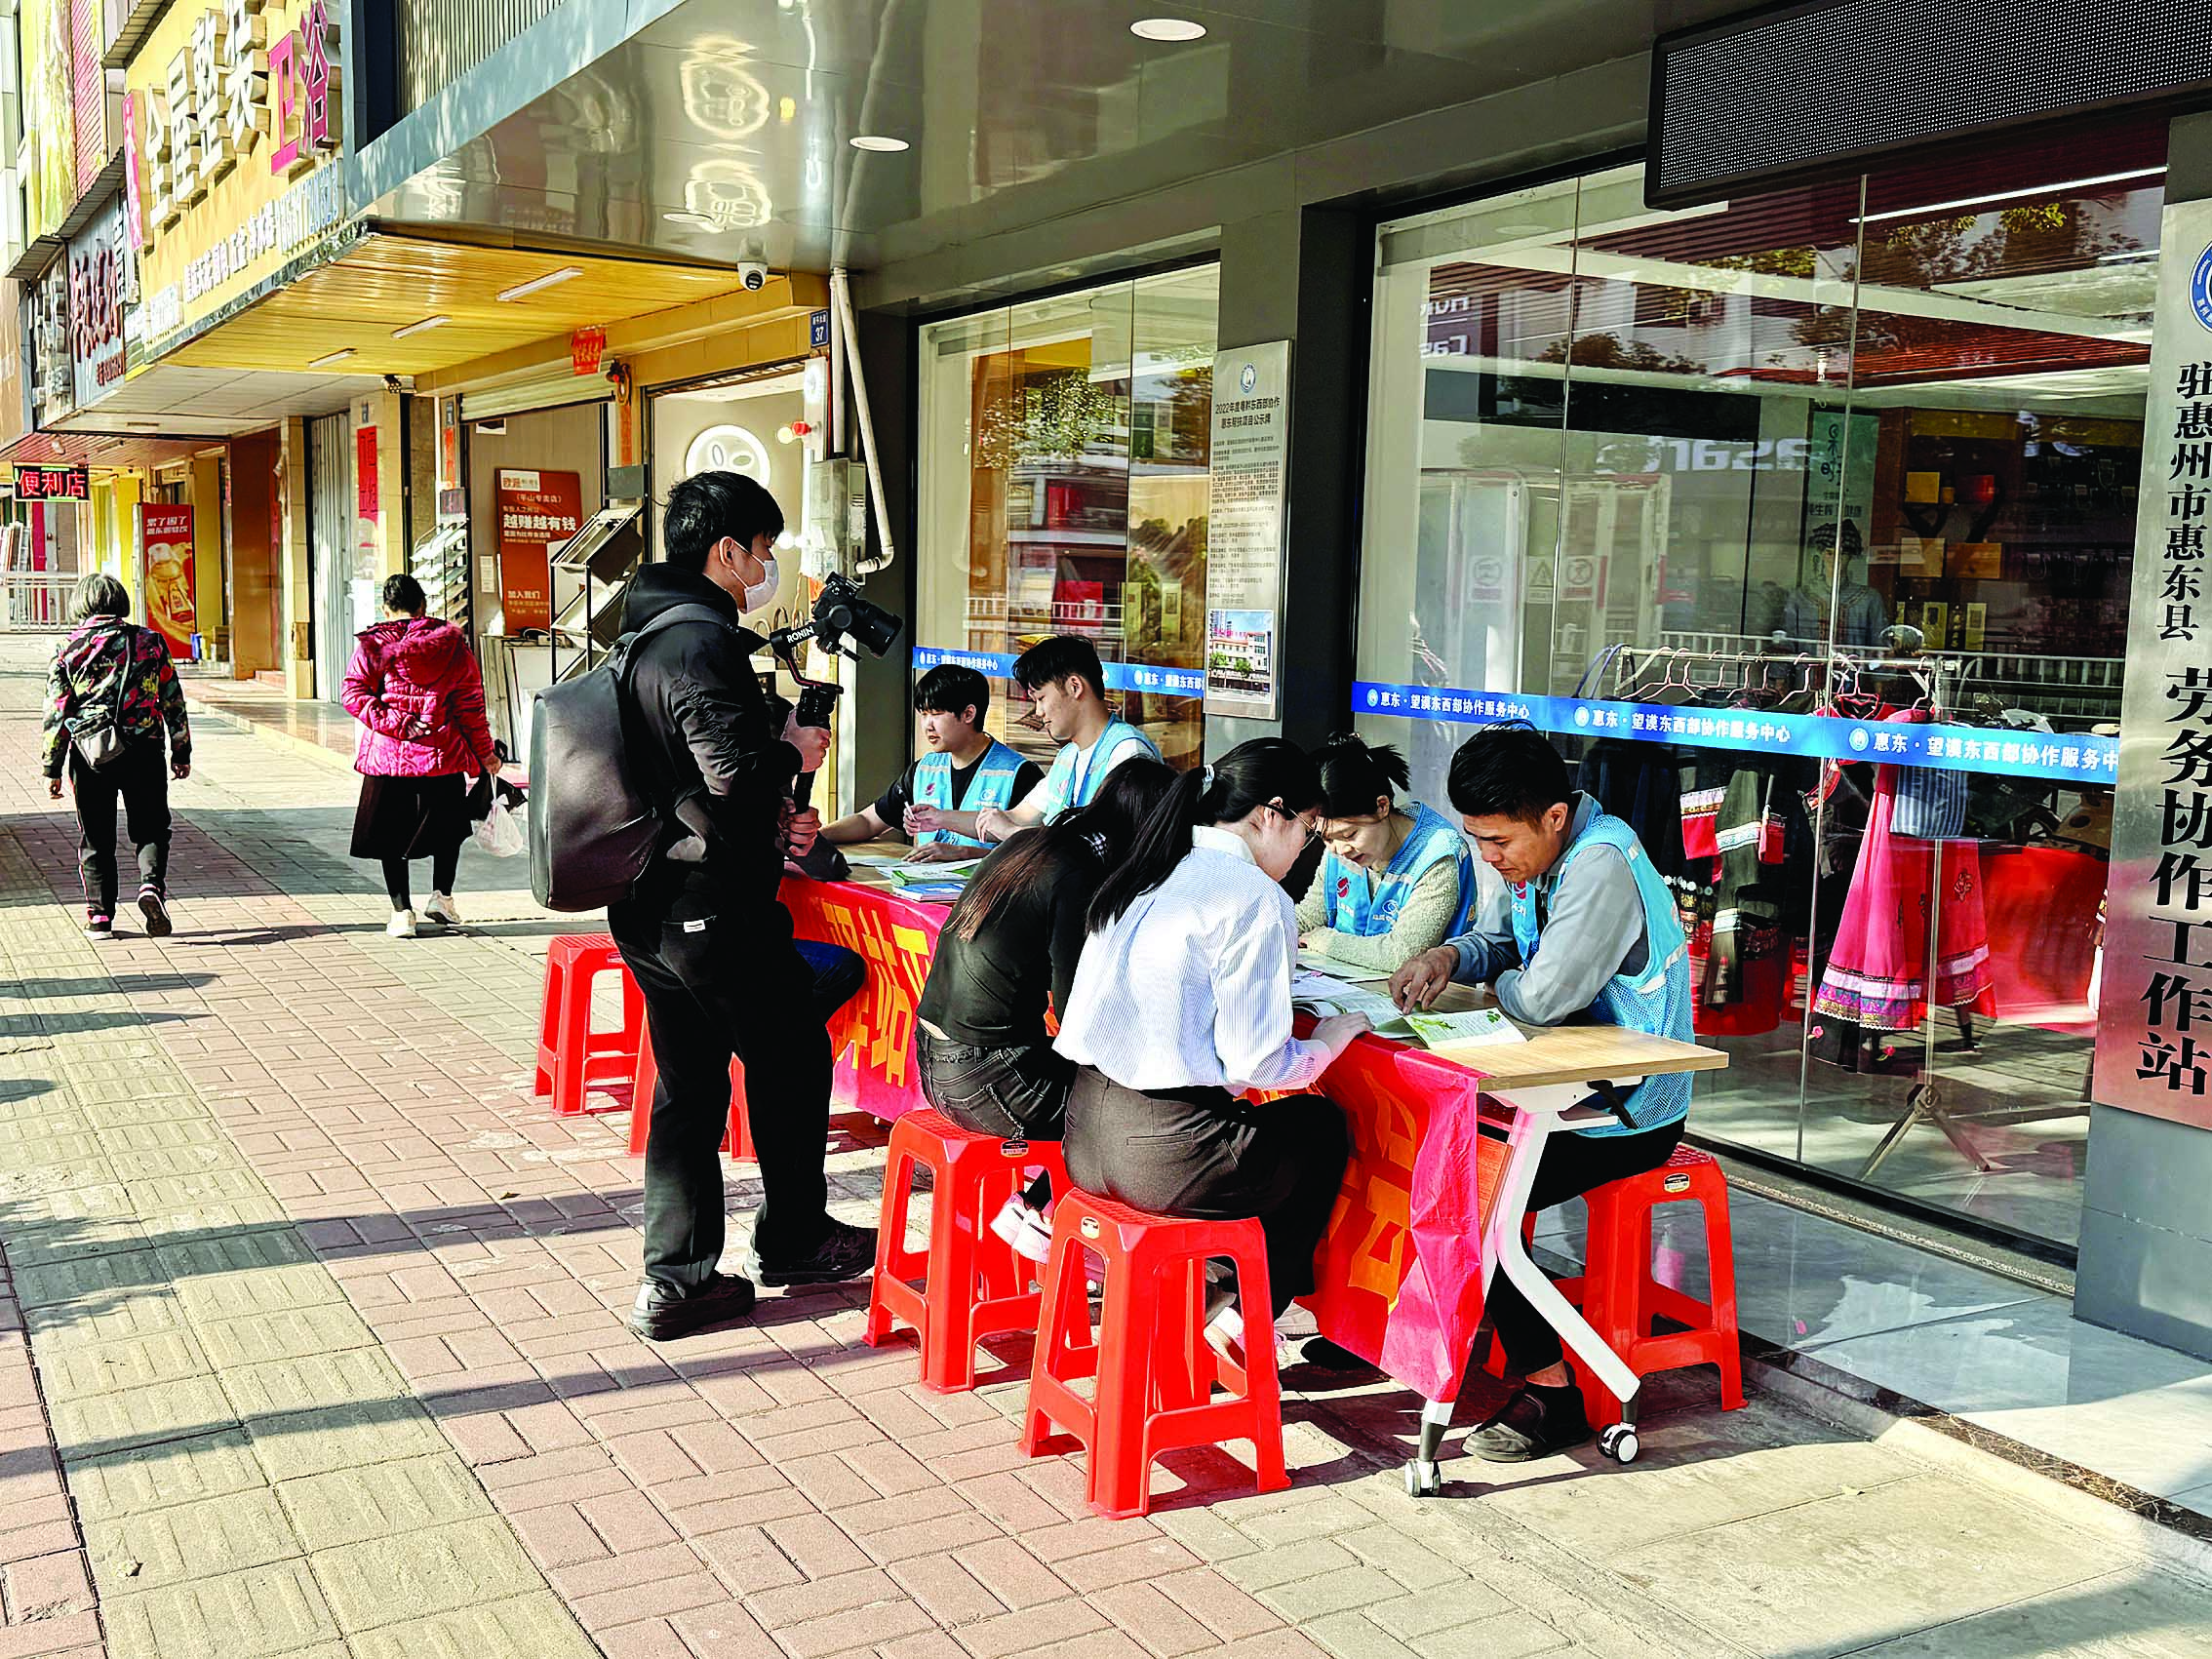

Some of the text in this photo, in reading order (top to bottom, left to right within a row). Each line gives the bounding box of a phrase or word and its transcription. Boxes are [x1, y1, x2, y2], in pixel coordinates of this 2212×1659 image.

[815, 326, 824, 342] 37
[19, 468, 86, 497] 便利店
[503, 514, 576, 532] 越赚越有钱
[786, 625, 815, 645] RONIN
[1380, 691, 1530, 720] 惠东·望谟东西部协作服务中心
[1592, 709, 1792, 743] 惠东·望谟东西部协作服务中心
[2135, 361, 2212, 1095] 驻惠州市惠东县 劳务协作工作站
